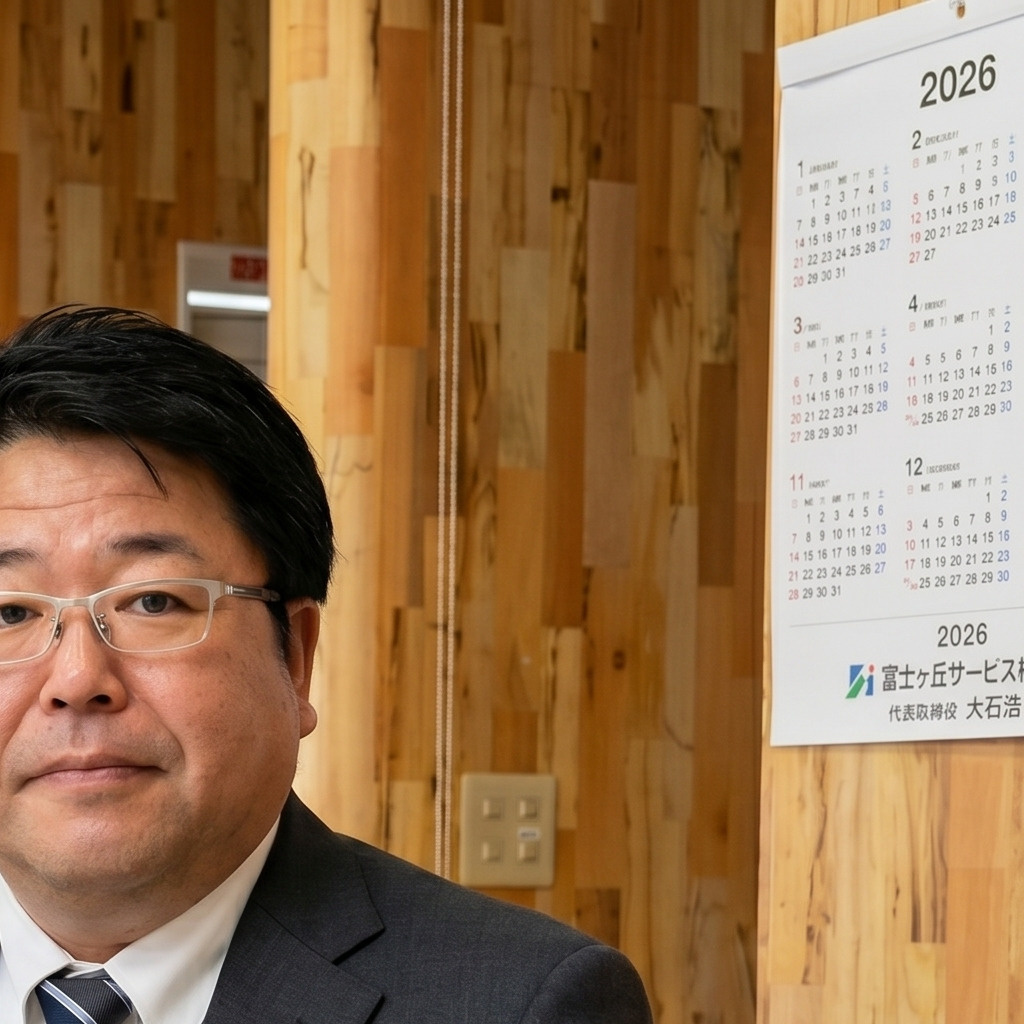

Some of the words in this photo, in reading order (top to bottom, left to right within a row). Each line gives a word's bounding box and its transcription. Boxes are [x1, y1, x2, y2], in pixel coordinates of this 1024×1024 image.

[920, 54, 996, 108] 2026
[912, 130, 921, 150] 2
[797, 160, 803, 178] 1
[976, 159, 982, 171] 2
[992, 155, 998, 167] 3
[1009, 150, 1015, 163] 3
[928, 189, 934, 202] 6
[944, 185, 950, 198] 7
[959, 182, 966, 195] 8
[975, 178, 982, 191] 9
[1005, 170, 1017, 183] 10
[926, 208, 937, 221] 13
[941, 205, 952, 217] 14
[957, 201, 968, 214] 15
[973, 197, 984, 211] 16
[989, 193, 1000, 207] 17
[1005, 190, 1017, 203] 18
[924, 228, 936, 242] 20
[939, 225, 951, 238] 21
[955, 221, 968, 235] 22
[971, 218, 984, 232] 23
[987, 215, 1000, 228] 24
[1003, 210, 1016, 224] 25
[909, 251, 921, 264] 27
[924, 247, 936, 261] 27
[908, 294, 918, 312] 4
[793, 316, 802, 335] 3
[989, 324, 993, 336] 1
[1004, 320, 1011, 333] 2
[823, 353, 827, 364] 1
[836, 350, 843, 362] 2
[851, 347, 857, 360] 3
[866, 345, 871, 356] 4
[940, 352, 946, 363] 5
[955, 349, 962, 361] 6
[972, 346, 978, 358] 7
[987, 343, 994, 356] 8
[1004, 340, 1010, 353] 9
[808, 373, 814, 385] 7
[836, 369, 842, 381] 9
[849, 366, 860, 378] 10
[864, 364, 873, 376] 11
[923, 373, 933, 385] 11
[938, 370, 949, 383] 12
[954, 368, 965, 380] 13
[970, 365, 981, 377] 14
[1001, 359, 1013, 372] 16
[806, 392, 816, 403] 14
[848, 385, 859, 397] 17
[922, 392, 934, 404] 18
[938, 390, 949, 402] 19
[952, 388, 964, 401] 20
[968, 385, 979, 398] 21
[984, 383, 997, 396] 22
[804, 411, 815, 423] 21
[818, 408, 830, 421] 22
[833, 406, 844, 419] 23
[847, 404, 859, 417] 24
[921, 412, 934, 425] 25
[952, 407, 964, 421] 27
[984, 403, 996, 416] 29
[847, 424, 857, 436] 31
[905, 457, 923, 476] 12
[790, 473, 804, 491] 11
[986, 492, 990, 503] 1
[1001, 489, 1007, 502] 2
[807, 513, 811, 524] 1
[819, 511, 825, 523] 2
[834, 509, 840, 521] 3
[848, 508, 854, 518] 4
[863, 506, 869, 518] 5
[922, 519, 928, 529] 4
[938, 516, 944, 528] 5
[953, 515, 960, 527] 6
[969, 513, 975, 525] 7
[984, 511, 991, 524] 8
[1001, 509, 1007, 522] 9
[805, 531, 811, 543] 8
[819, 530, 825, 541] 9
[846, 527, 856, 538] 11
[861, 525, 872, 537] 12
[920, 538, 930, 549] 11
[935, 536, 947, 548] 12
[951, 534, 962, 547] 13
[967, 533, 978, 545] 14
[982, 531, 994, 543] 15
[998, 529, 1010, 542] 16
[832, 547, 842, 558] 17
[861, 544, 872, 556] 19
[935, 556, 946, 568] 19
[950, 554, 962, 567] 20
[965, 553, 977, 565] 21
[981, 551, 994, 564] 22
[802, 568, 813, 581] 22
[831, 566, 842, 578] 24
[860, 563, 871, 575] 26
[919, 577, 931, 589] 25
[949, 574, 961, 586] 27
[981, 571, 993, 584] 29
[831, 585, 841, 597] 31
[937, 622, 987, 647] 2026
[966, 693, 1022, 720] 大石浩
